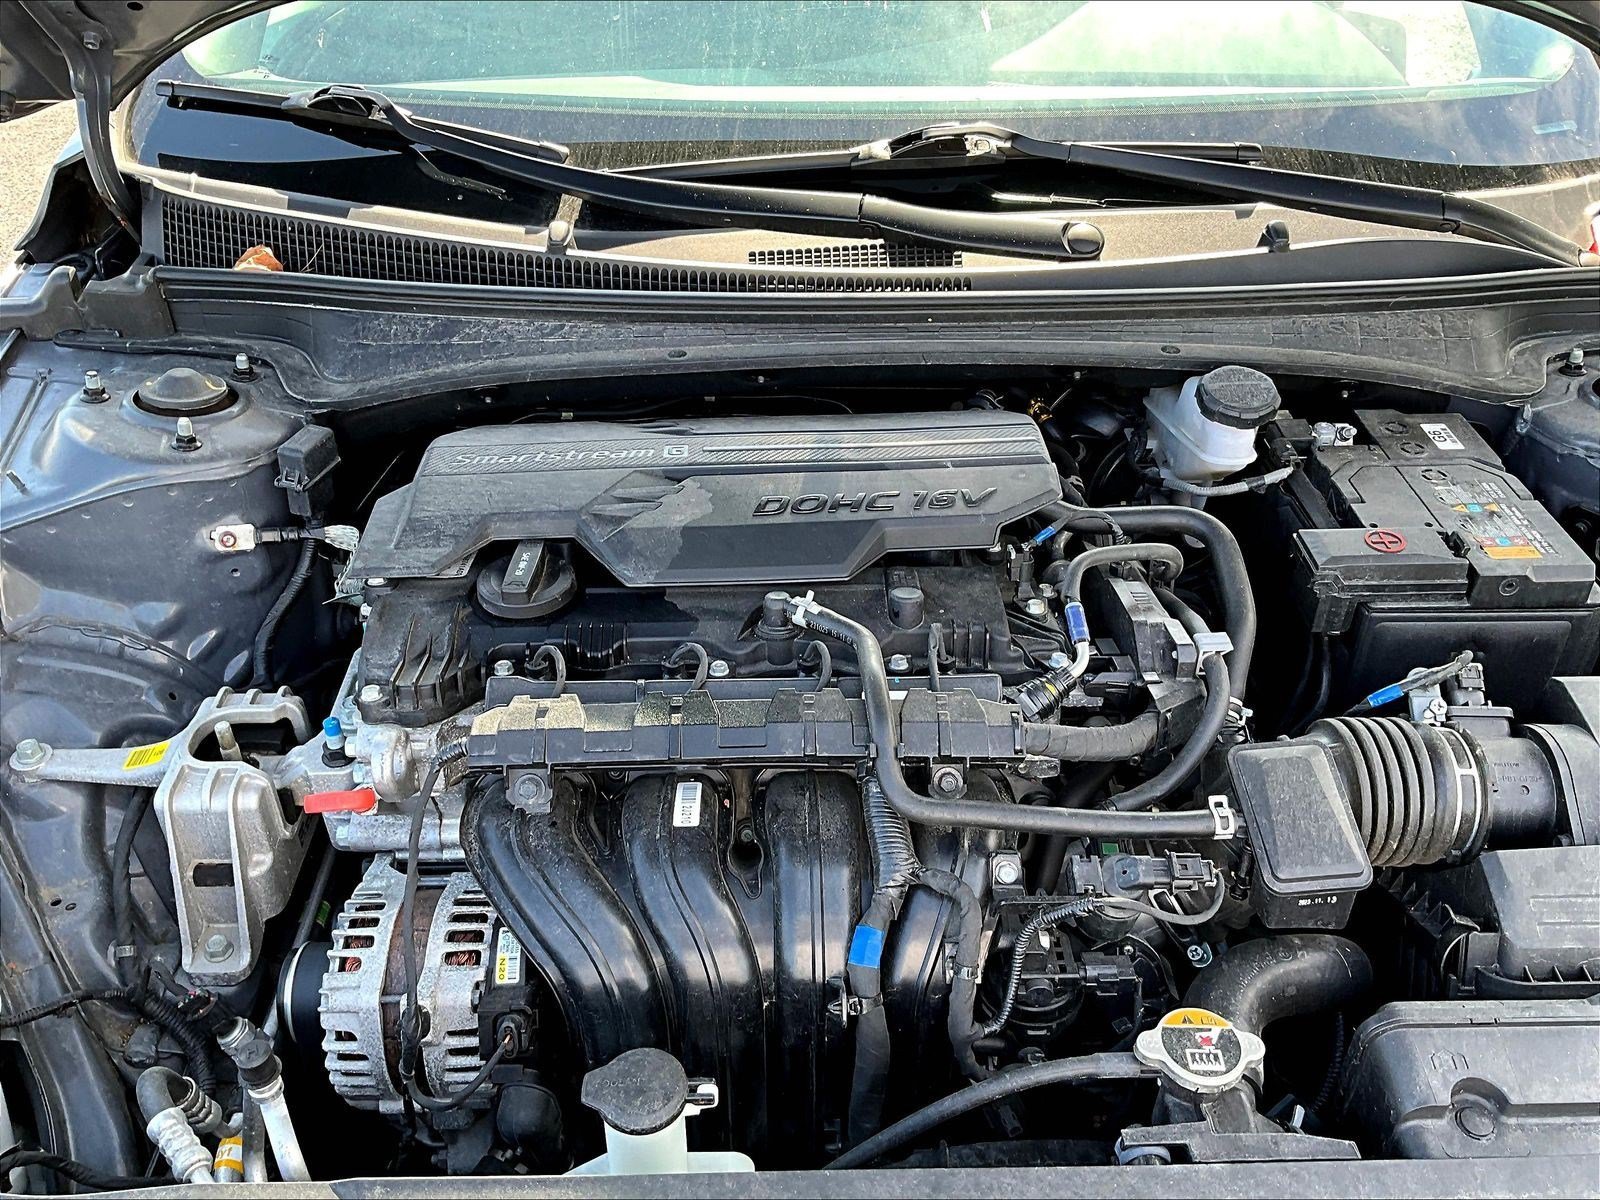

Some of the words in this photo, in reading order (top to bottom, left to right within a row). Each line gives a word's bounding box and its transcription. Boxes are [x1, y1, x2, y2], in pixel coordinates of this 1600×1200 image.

[451, 446, 655, 467] Smartstream
[752, 490, 901, 517] DOHC
[912, 487, 998, 510] 16V
